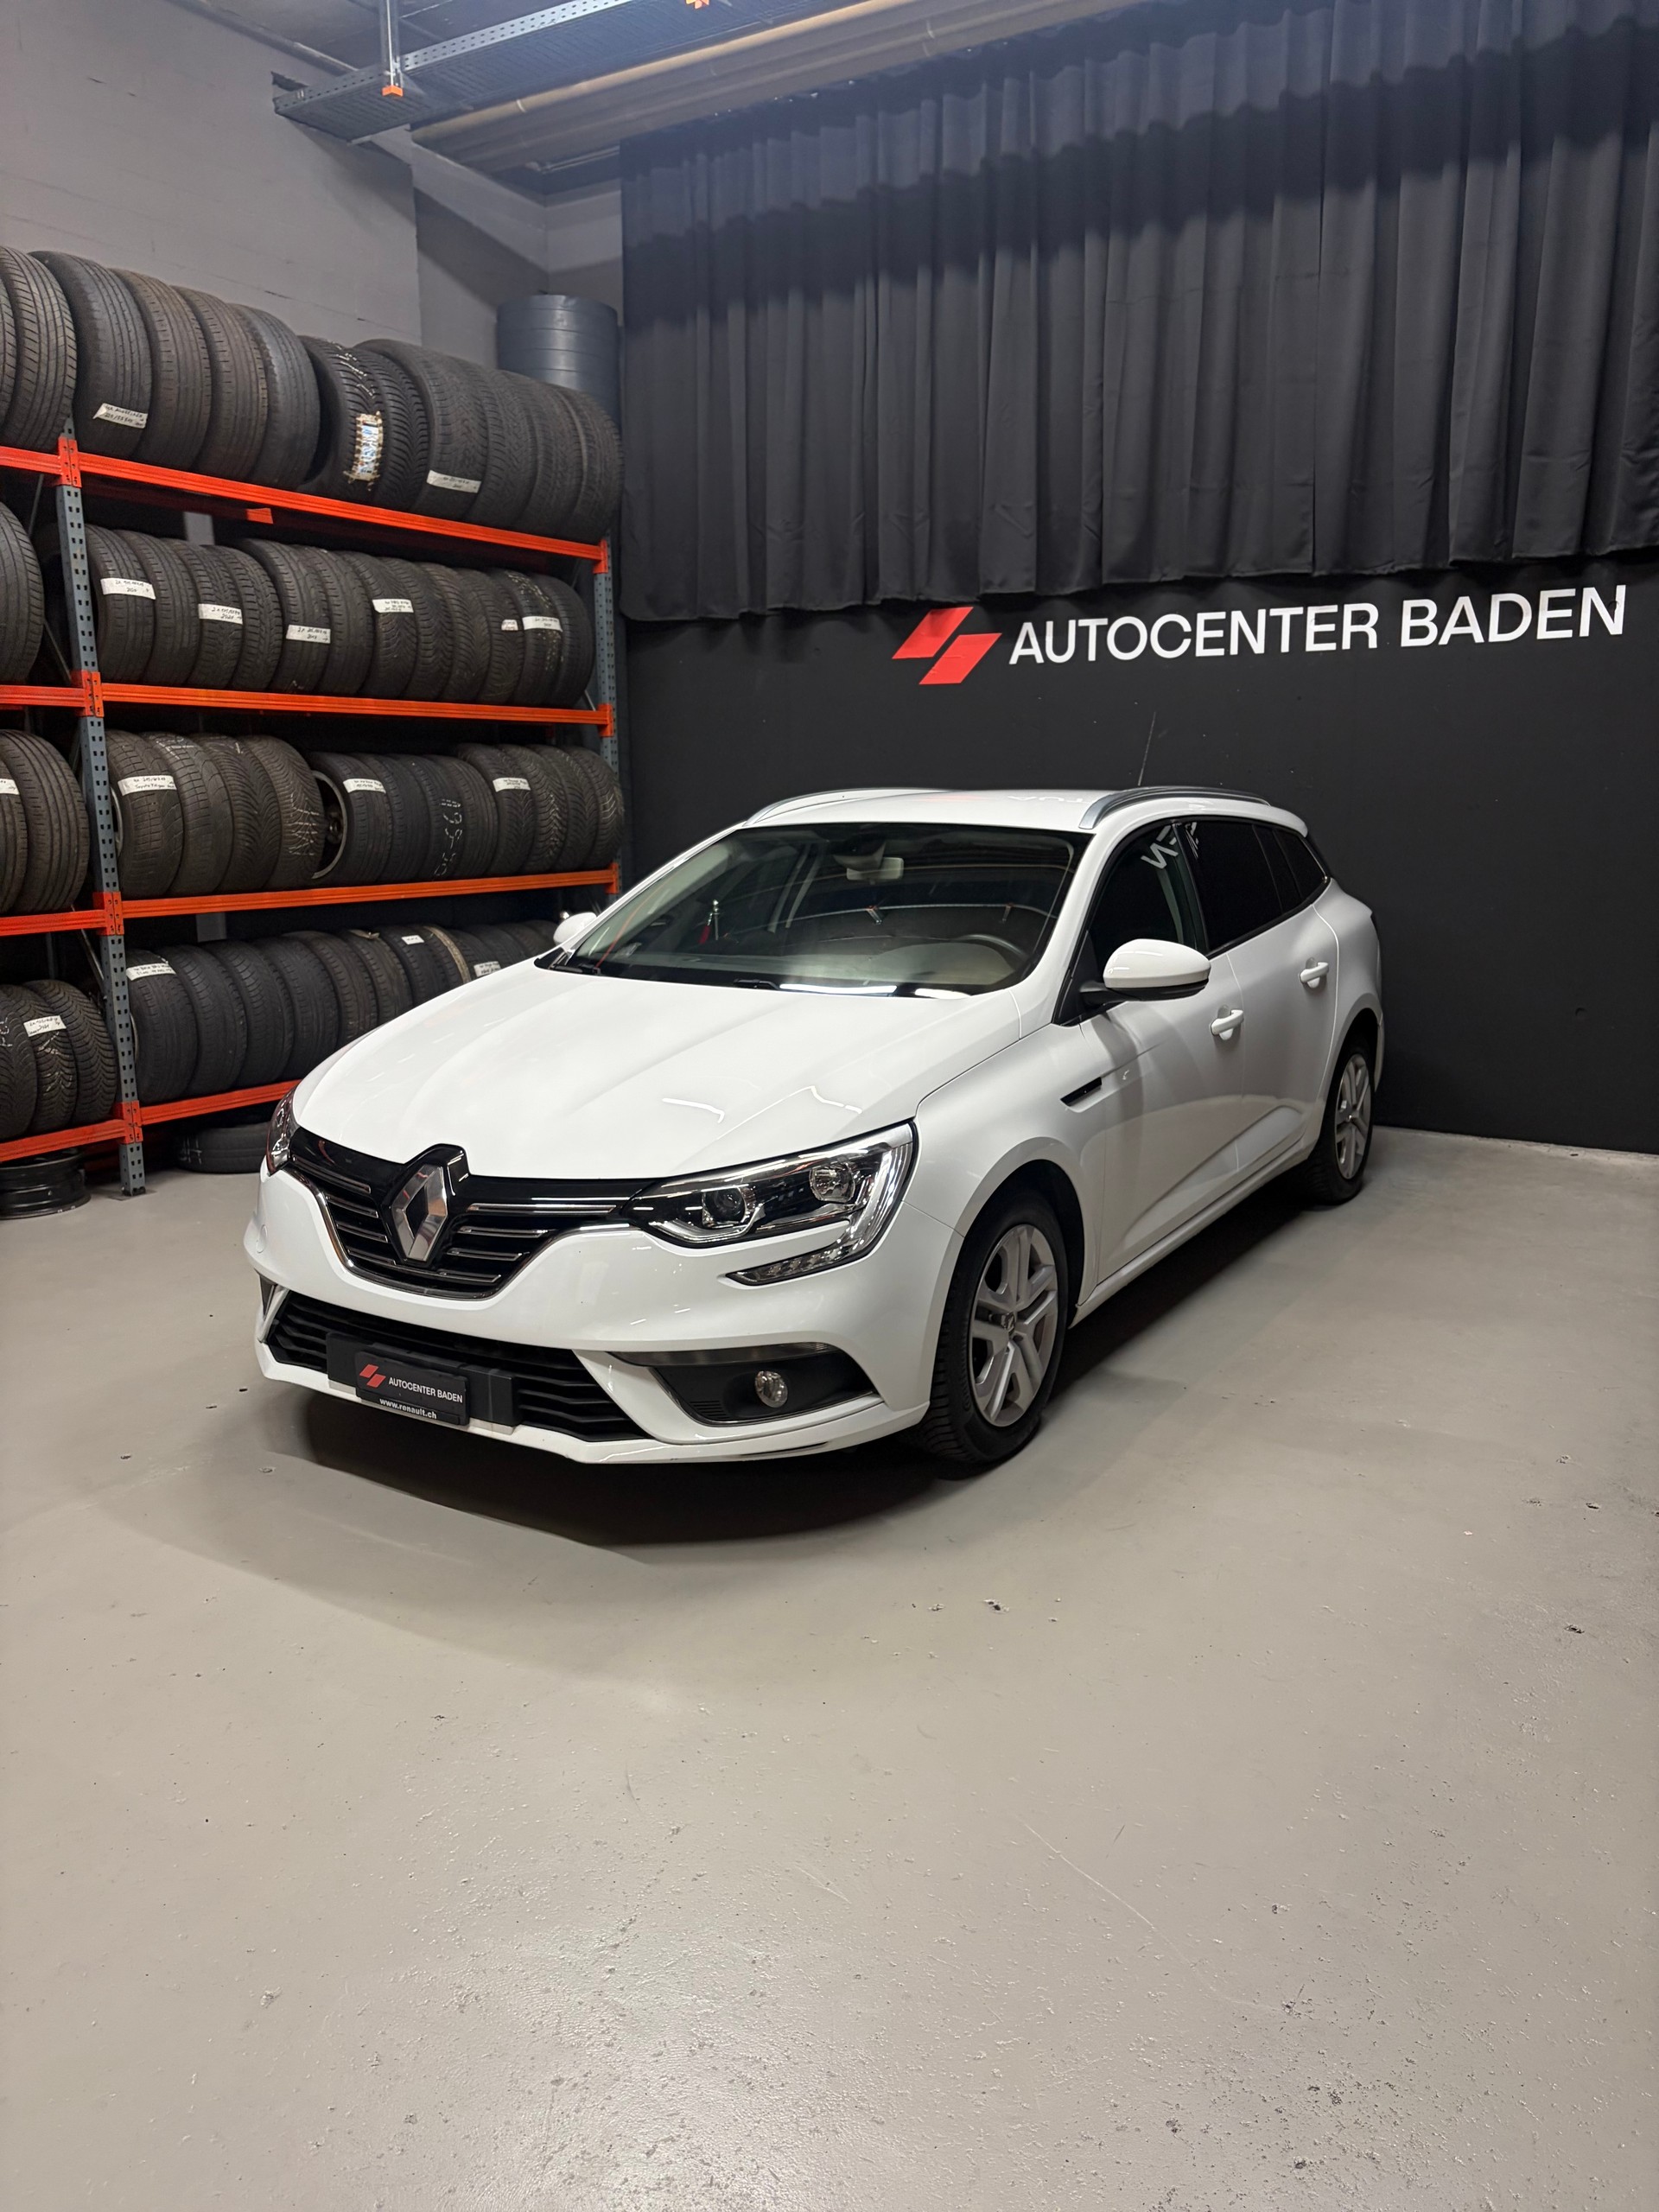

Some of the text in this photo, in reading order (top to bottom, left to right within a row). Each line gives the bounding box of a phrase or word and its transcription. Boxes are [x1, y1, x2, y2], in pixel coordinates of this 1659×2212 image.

[1008, 584, 1626, 665] AUTOCENTER BADEN
[388, 1376, 463, 1403] AUTOCENTER BADEN
[379, 1398, 437, 1420] www.renault.ch
